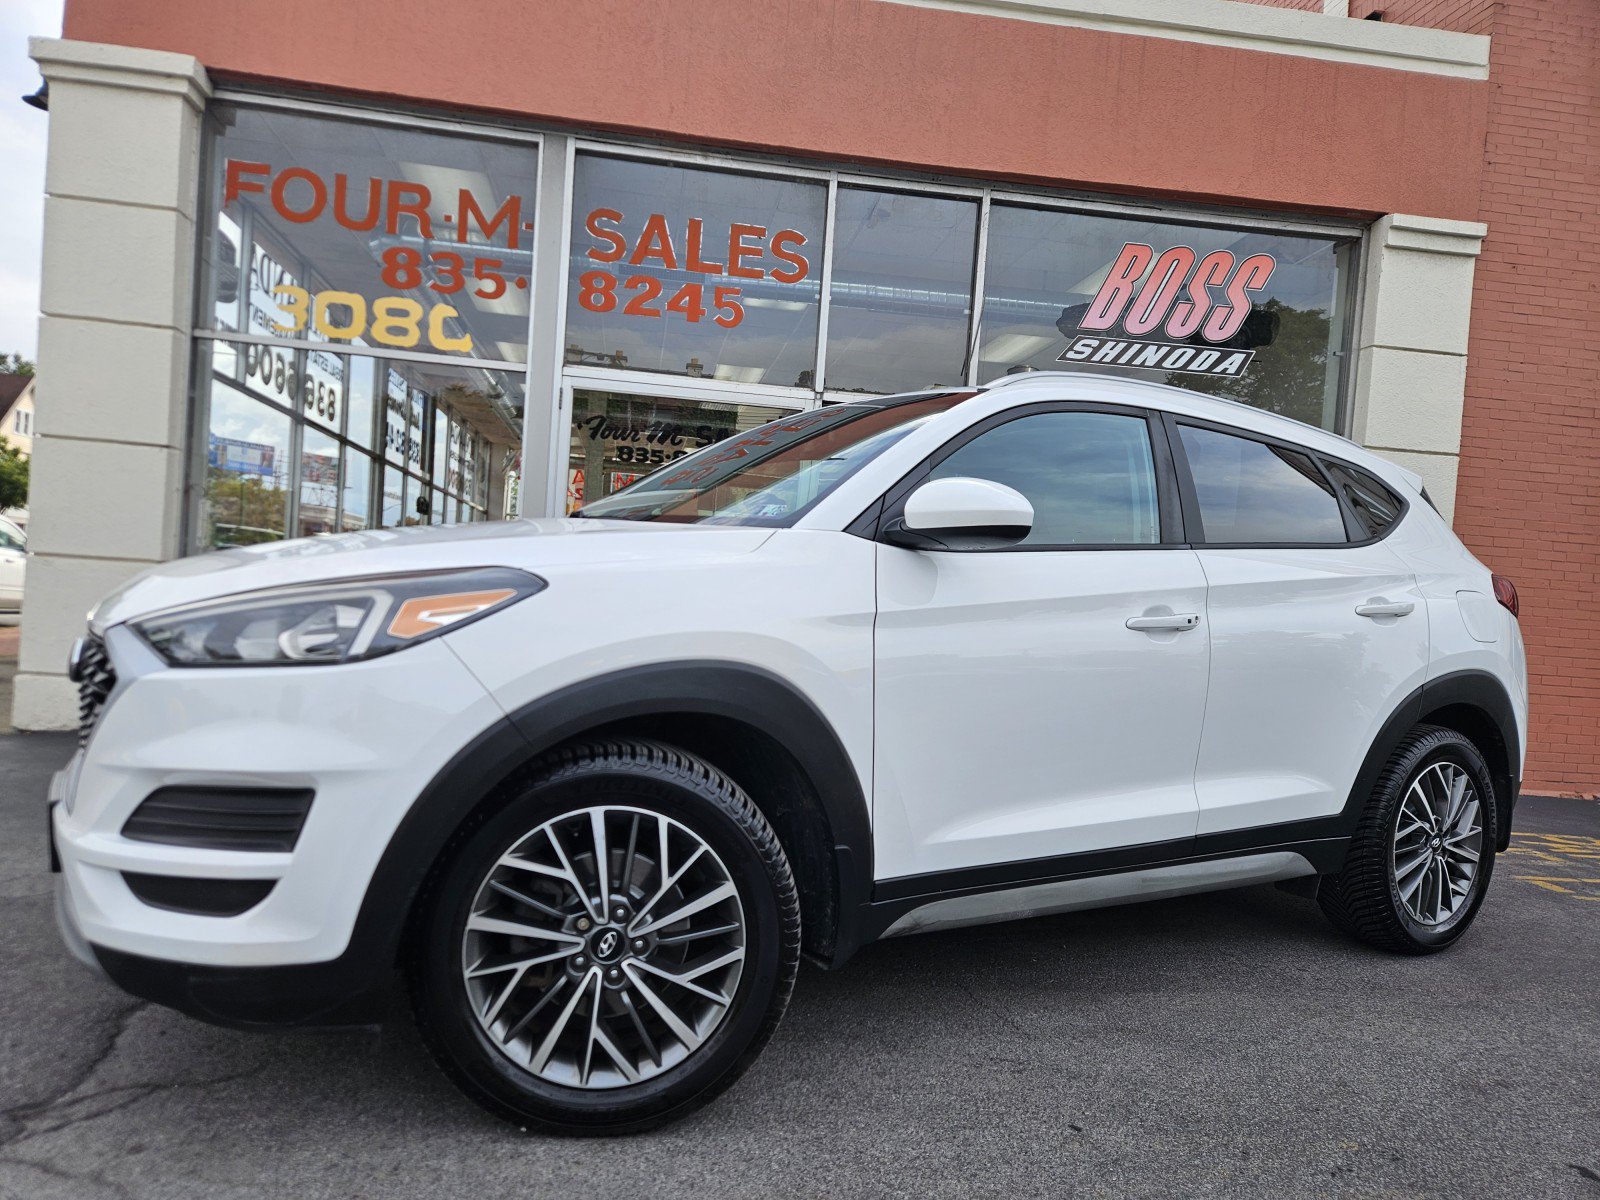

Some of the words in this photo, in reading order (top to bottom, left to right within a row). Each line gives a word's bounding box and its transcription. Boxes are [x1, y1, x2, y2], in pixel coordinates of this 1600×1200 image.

[585, 207, 810, 284] SALES
[578, 270, 745, 329] 8245
[1076, 241, 1277, 343] BOSS
[1065, 338, 1249, 374] SHINODA
